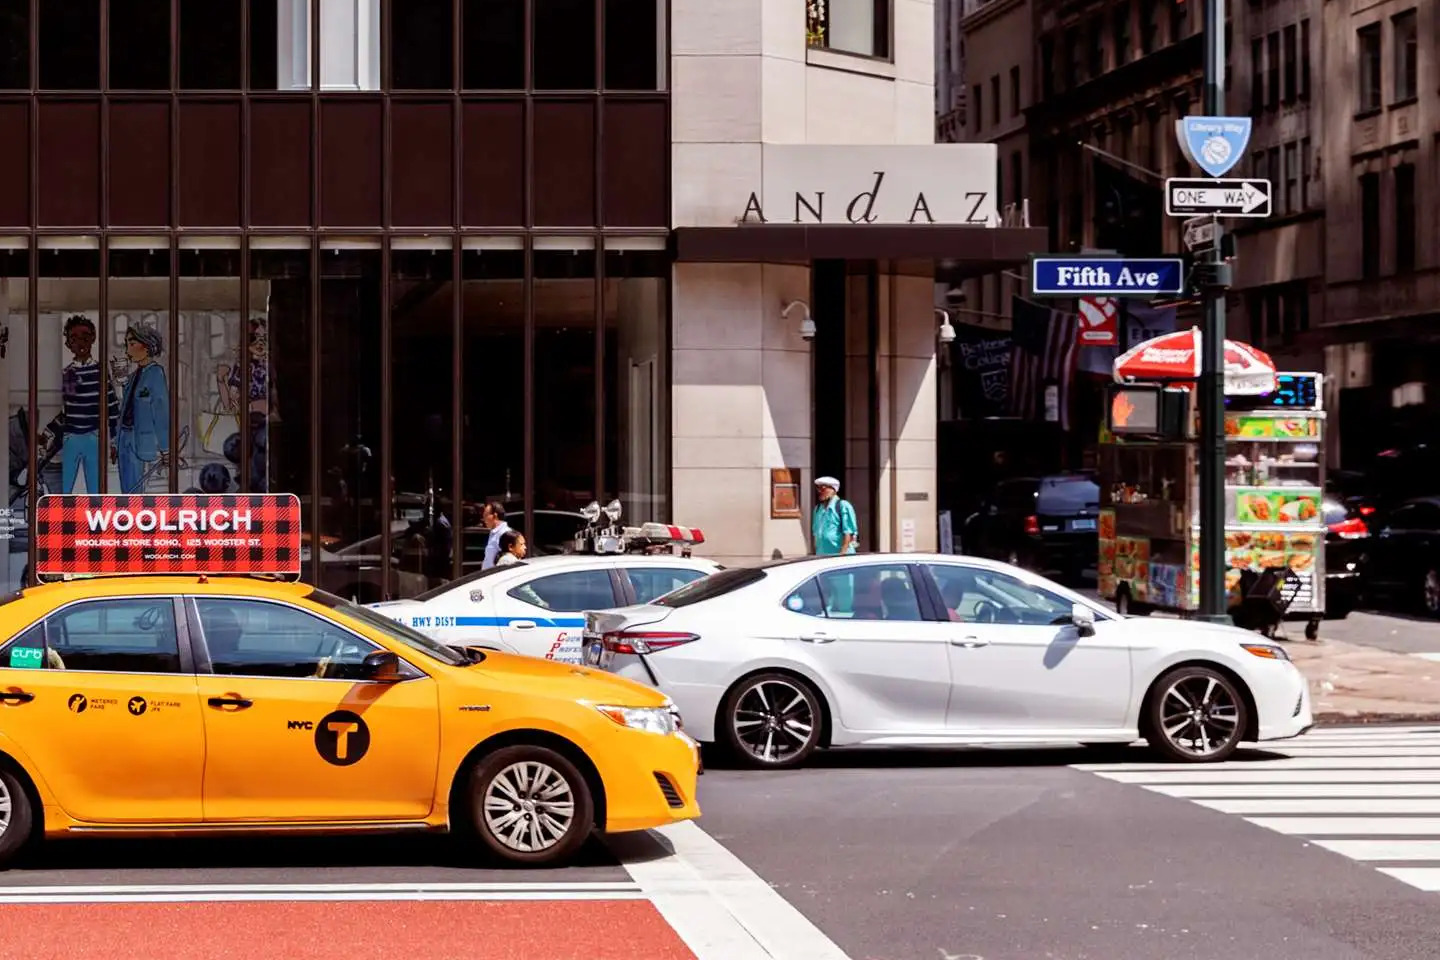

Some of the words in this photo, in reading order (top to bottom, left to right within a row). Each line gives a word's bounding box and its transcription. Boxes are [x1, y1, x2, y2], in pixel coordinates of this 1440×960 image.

[1176, 190, 1207, 204] ONE
[1224, 191, 1256, 204] WAY
[1057, 266, 1111, 286] Fifth
[1116, 268, 1160, 286] Ave
[86, 510, 251, 531] WOOLRICH
[412, 617, 431, 627] HWY
[435, 617, 456, 627] DIST
[11, 648, 43, 659] curb
[287, 720, 313, 730] NYC
[327, 722, 358, 759] T
